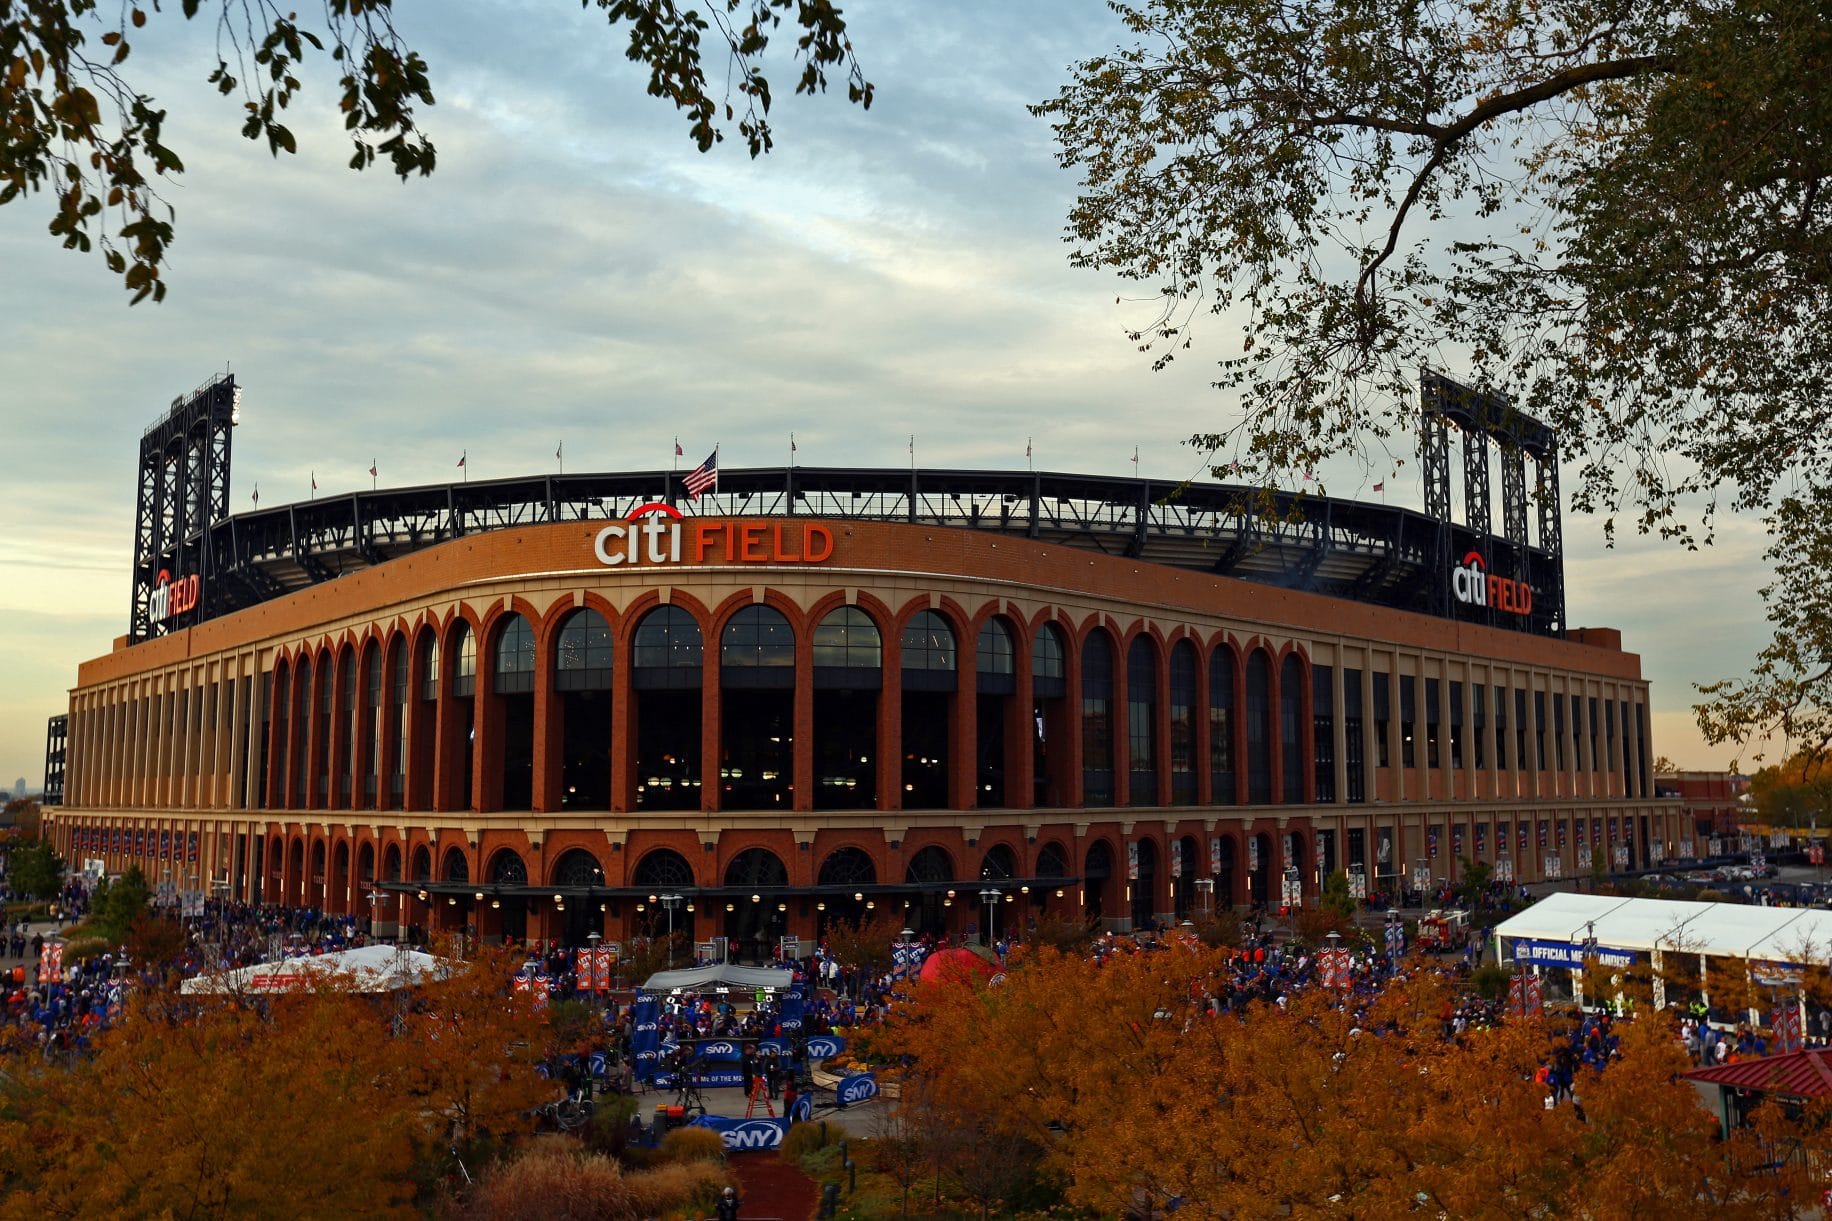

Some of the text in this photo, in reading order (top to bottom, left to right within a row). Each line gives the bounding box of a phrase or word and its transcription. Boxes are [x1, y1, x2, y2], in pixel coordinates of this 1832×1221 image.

[594, 508, 834, 566] citi FIELD
[1452, 558, 1532, 616] citi FIELD
[149, 574, 199, 624] citi FIELD
[1532, 946, 1570, 962] OFFICIAL
[637, 995, 655, 1003] SNY
[781, 991, 800, 1000] SNY
[781, 1020, 799, 1029] SNY
[705, 1045, 729, 1054] SNY
[808, 1045, 831, 1057] NY
[711, 1074, 720, 1083] OF
[719, 1074, 733, 1083] THE
[843, 1081, 872, 1102] SNY
[719, 1128, 776, 1149] SNY
